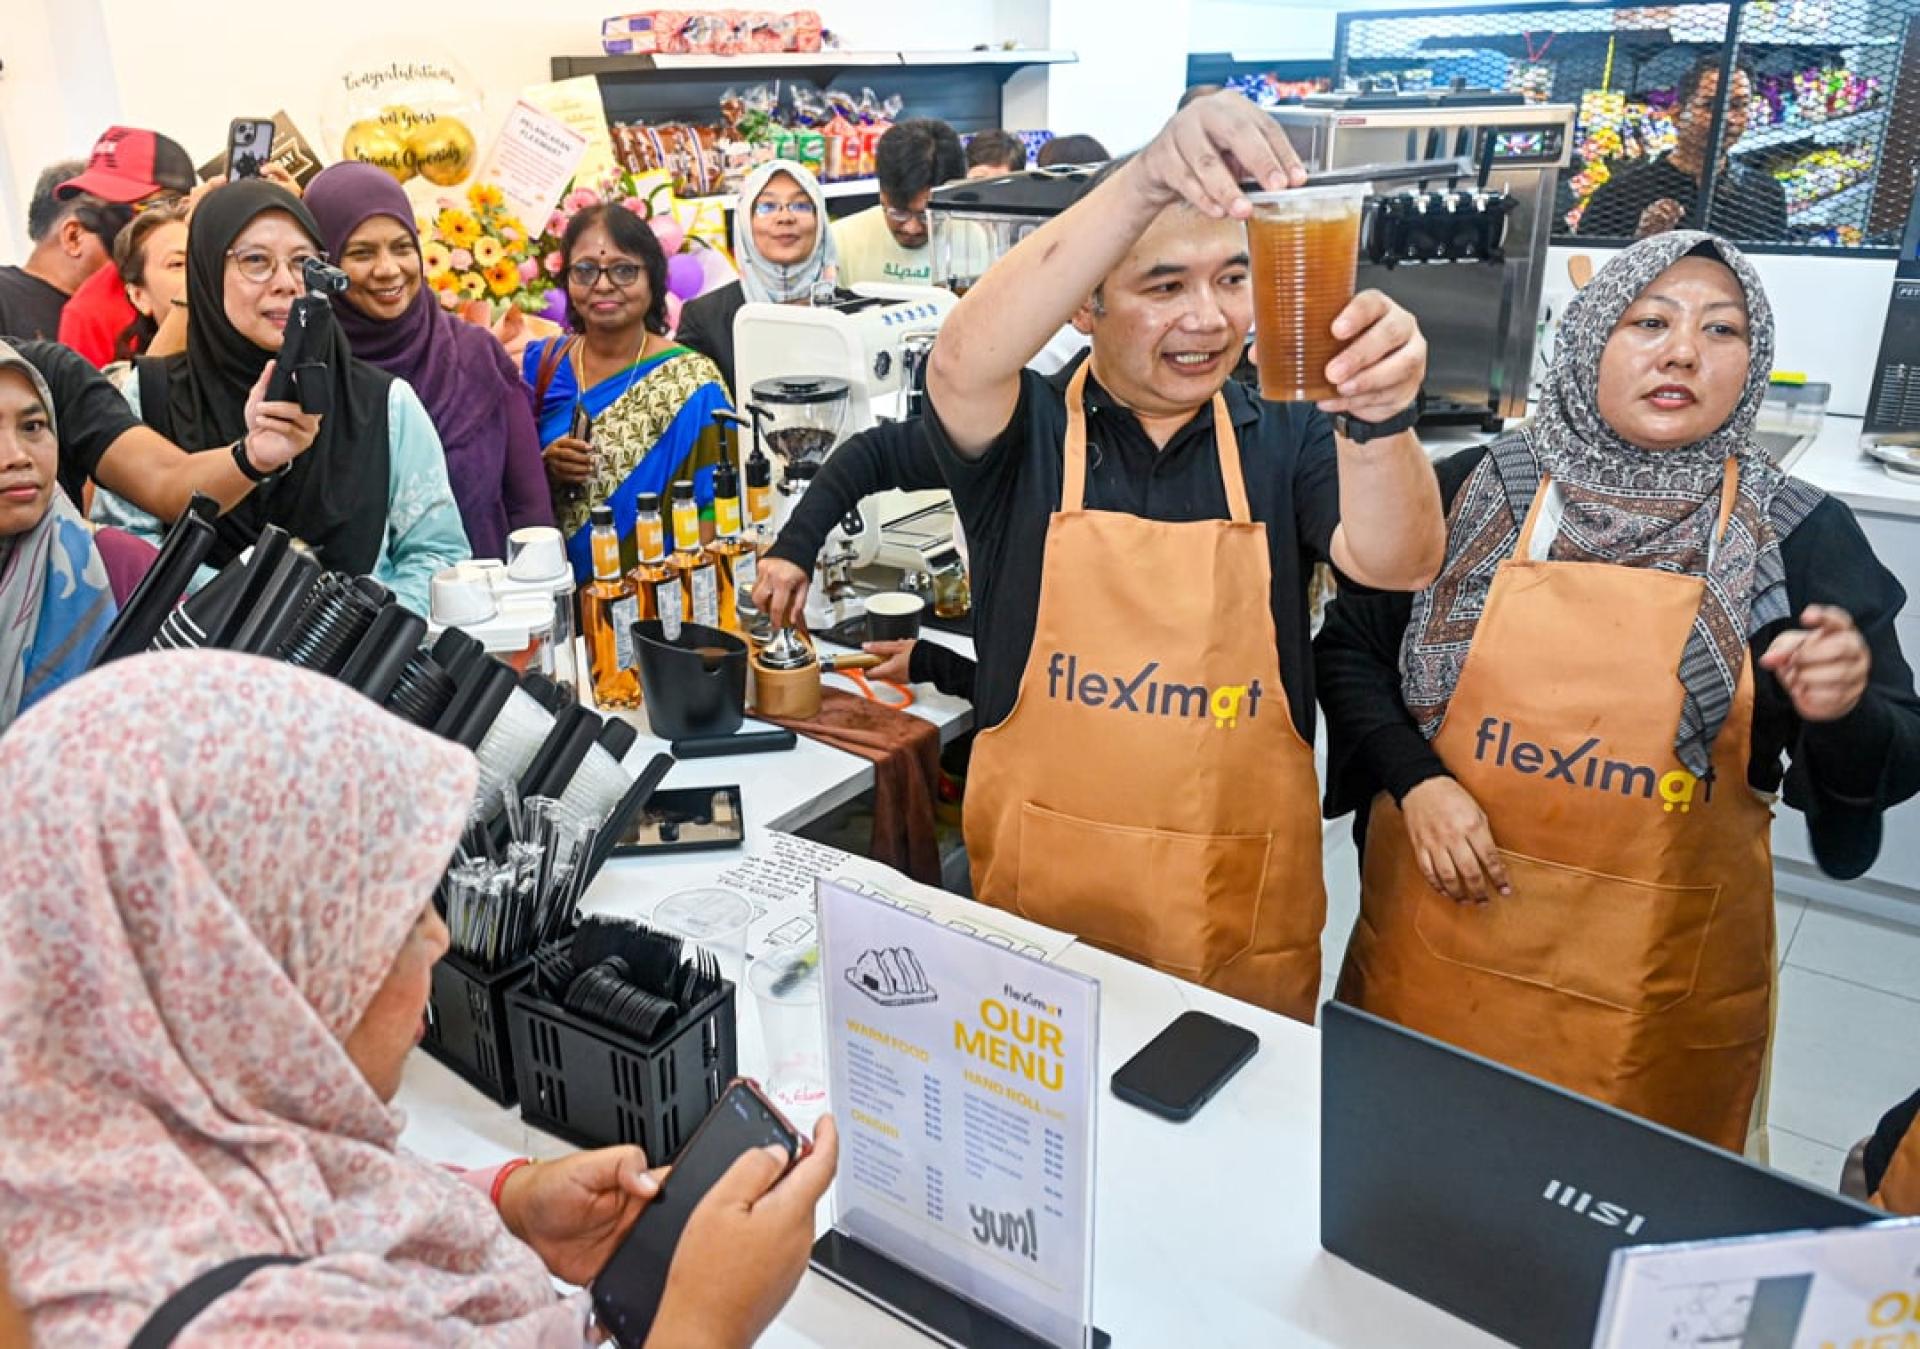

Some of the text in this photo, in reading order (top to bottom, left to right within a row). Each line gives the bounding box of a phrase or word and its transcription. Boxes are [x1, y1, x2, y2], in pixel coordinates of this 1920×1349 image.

[846, 1017, 929, 1064] WARM FOOD
[954, 1020, 1064, 1092] MENU
[980, 998, 1065, 1058] OUR
